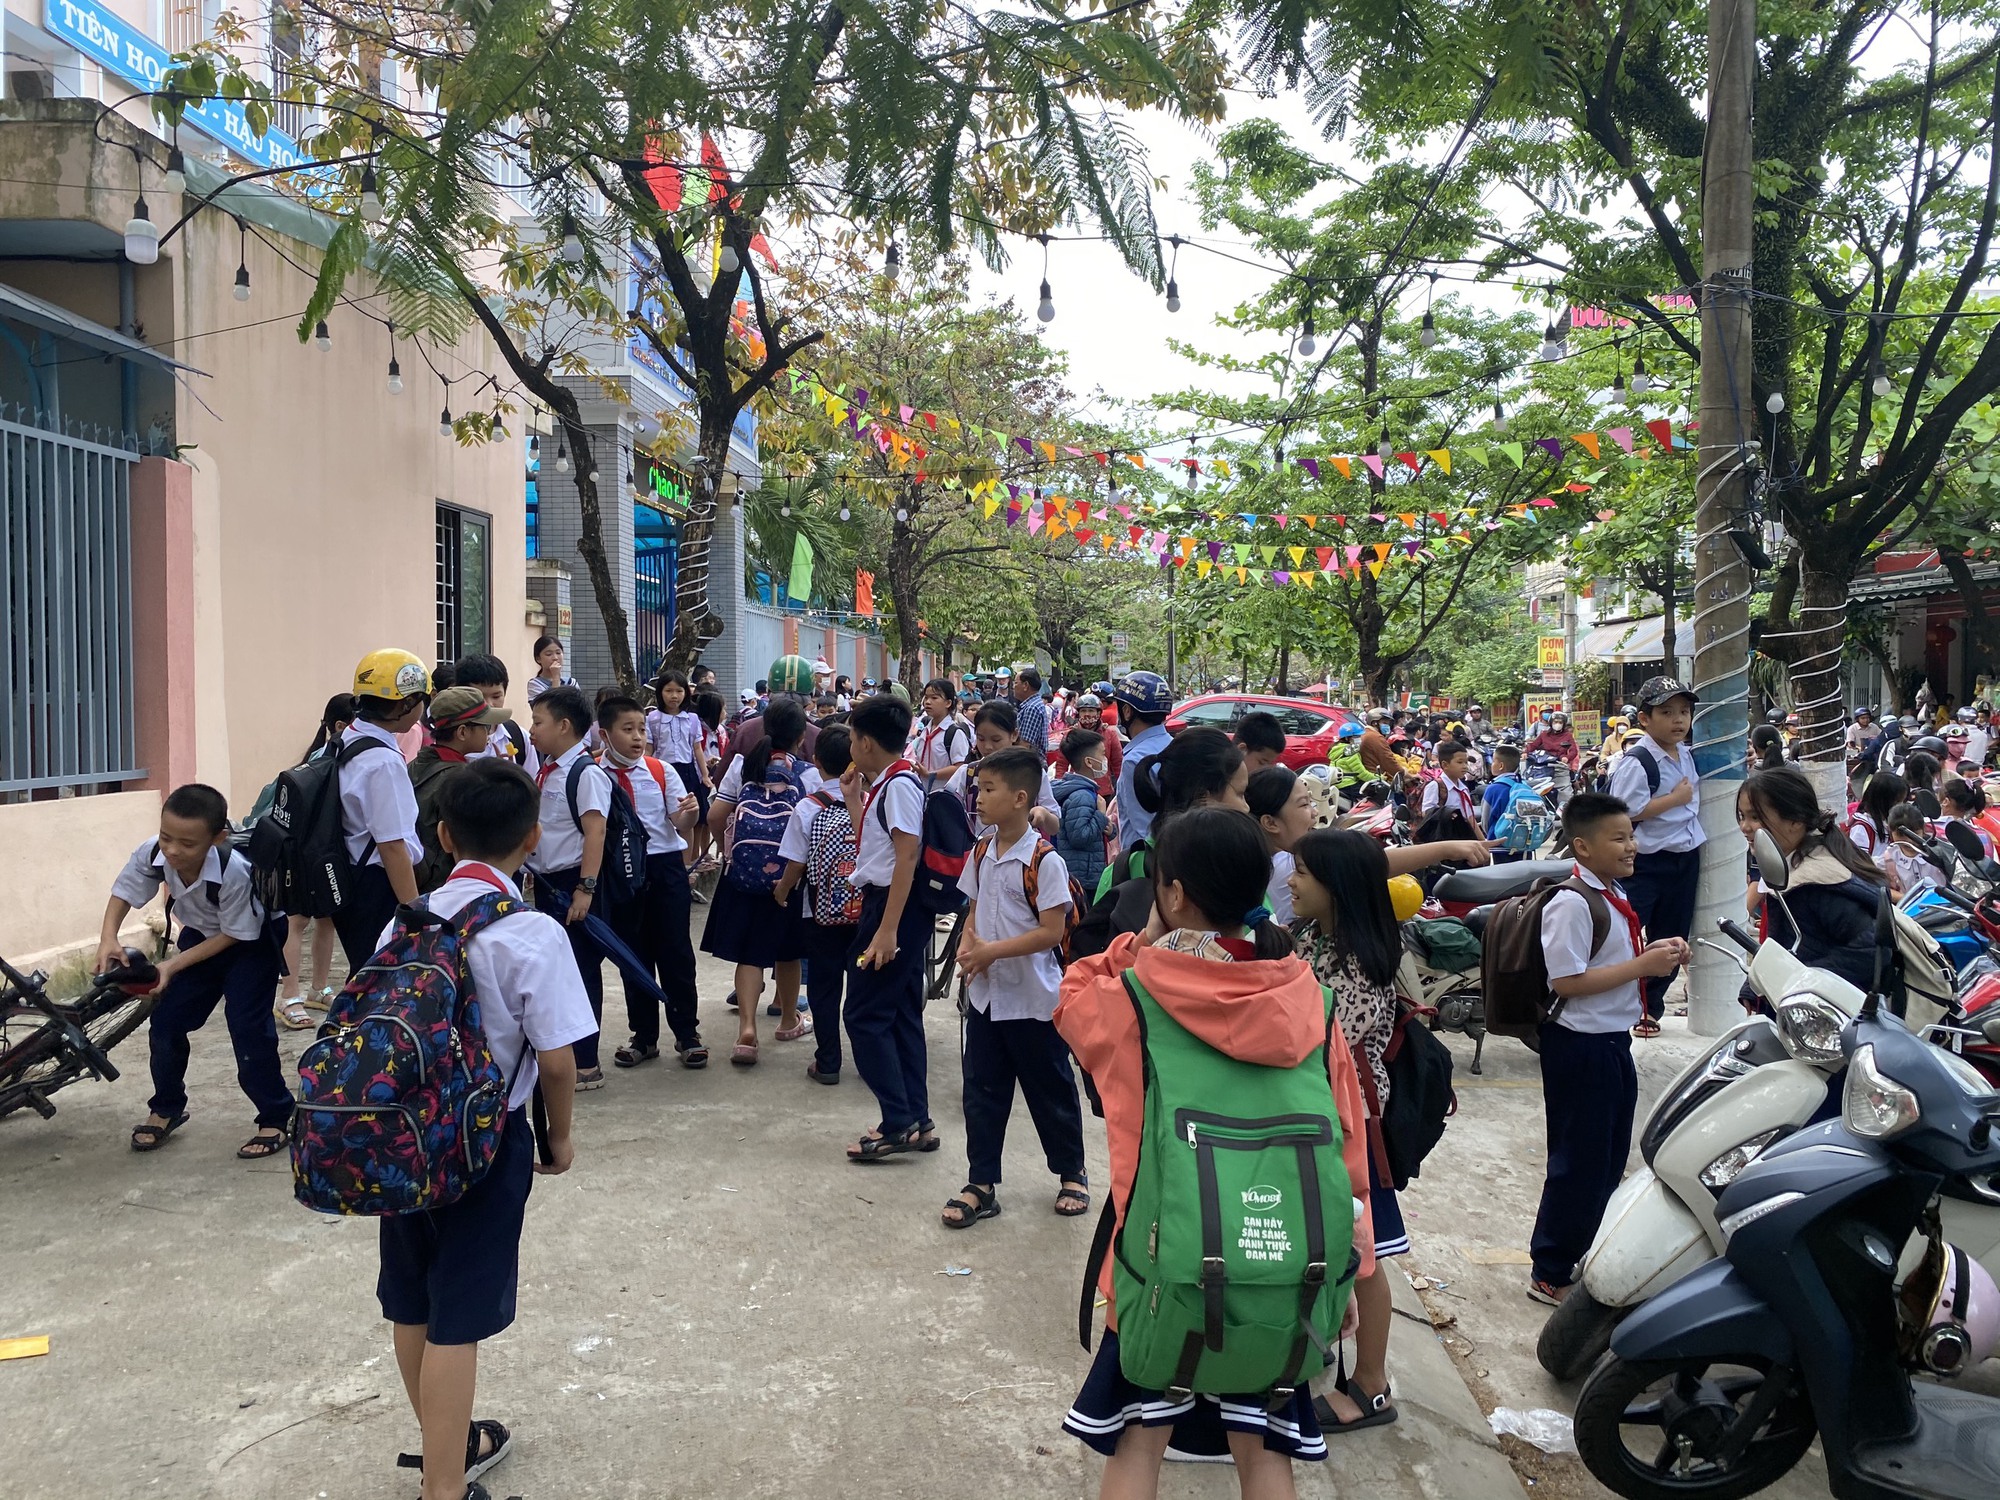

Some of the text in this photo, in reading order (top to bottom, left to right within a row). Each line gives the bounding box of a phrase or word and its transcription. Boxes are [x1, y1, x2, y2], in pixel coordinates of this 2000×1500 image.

[60, 0, 120, 58] TIÊN
[1542, 638, 1564, 649] CƠM
[1546, 650, 1559, 662] GÀ
[836, 860, 855, 877] 95
